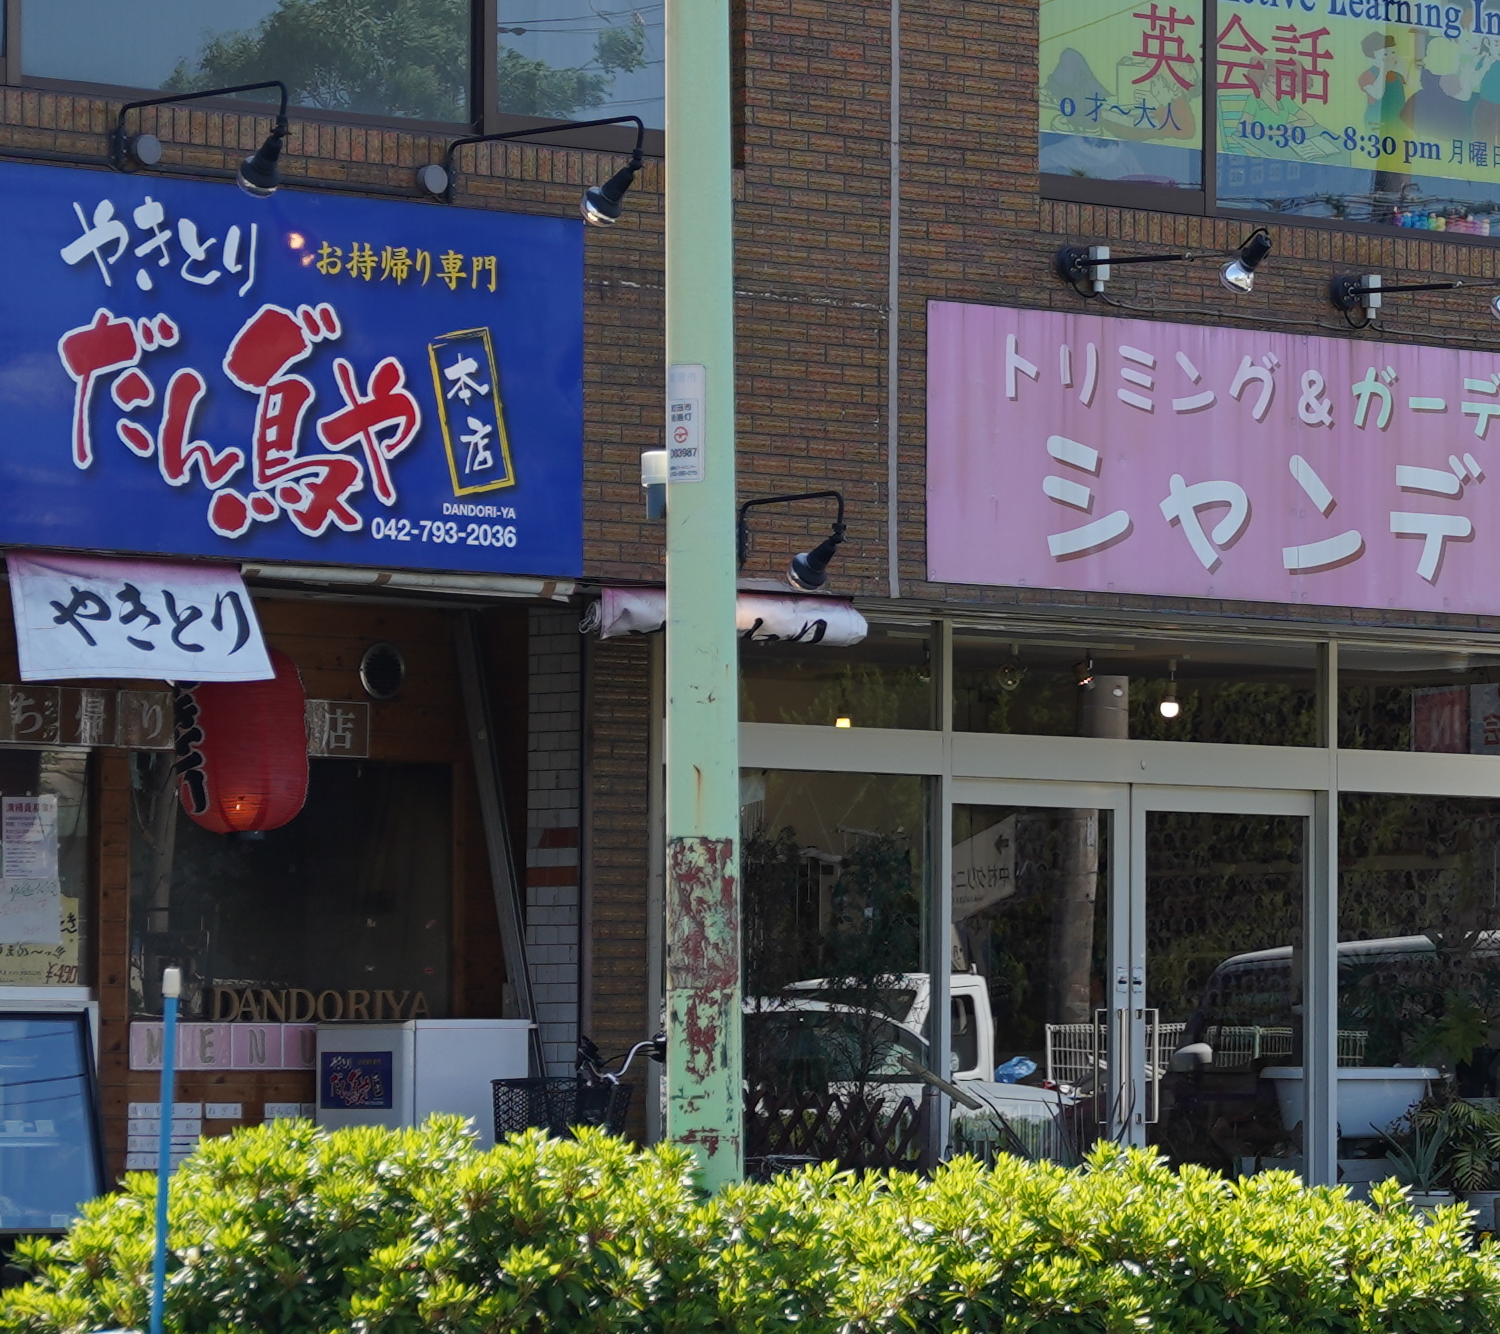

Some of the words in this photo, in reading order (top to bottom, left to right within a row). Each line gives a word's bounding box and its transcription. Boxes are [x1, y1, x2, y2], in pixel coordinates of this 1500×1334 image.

[1131, 2, 1332, 105] 英会話
[1239, 120, 1307, 150] 10:30
[1403, 139, 1442, 165] pm
[60, 196, 258, 297] やきとり
[315, 240, 498, 294] お持帰り専門
[443, 352, 494, 477] 本店
[370, 518, 517, 549] 042-793-2036
[442, 501, 517, 521] DANDORI-YA
[52, 581, 252, 655] やきとり
[212, 988, 430, 1022] DANDORIYA
